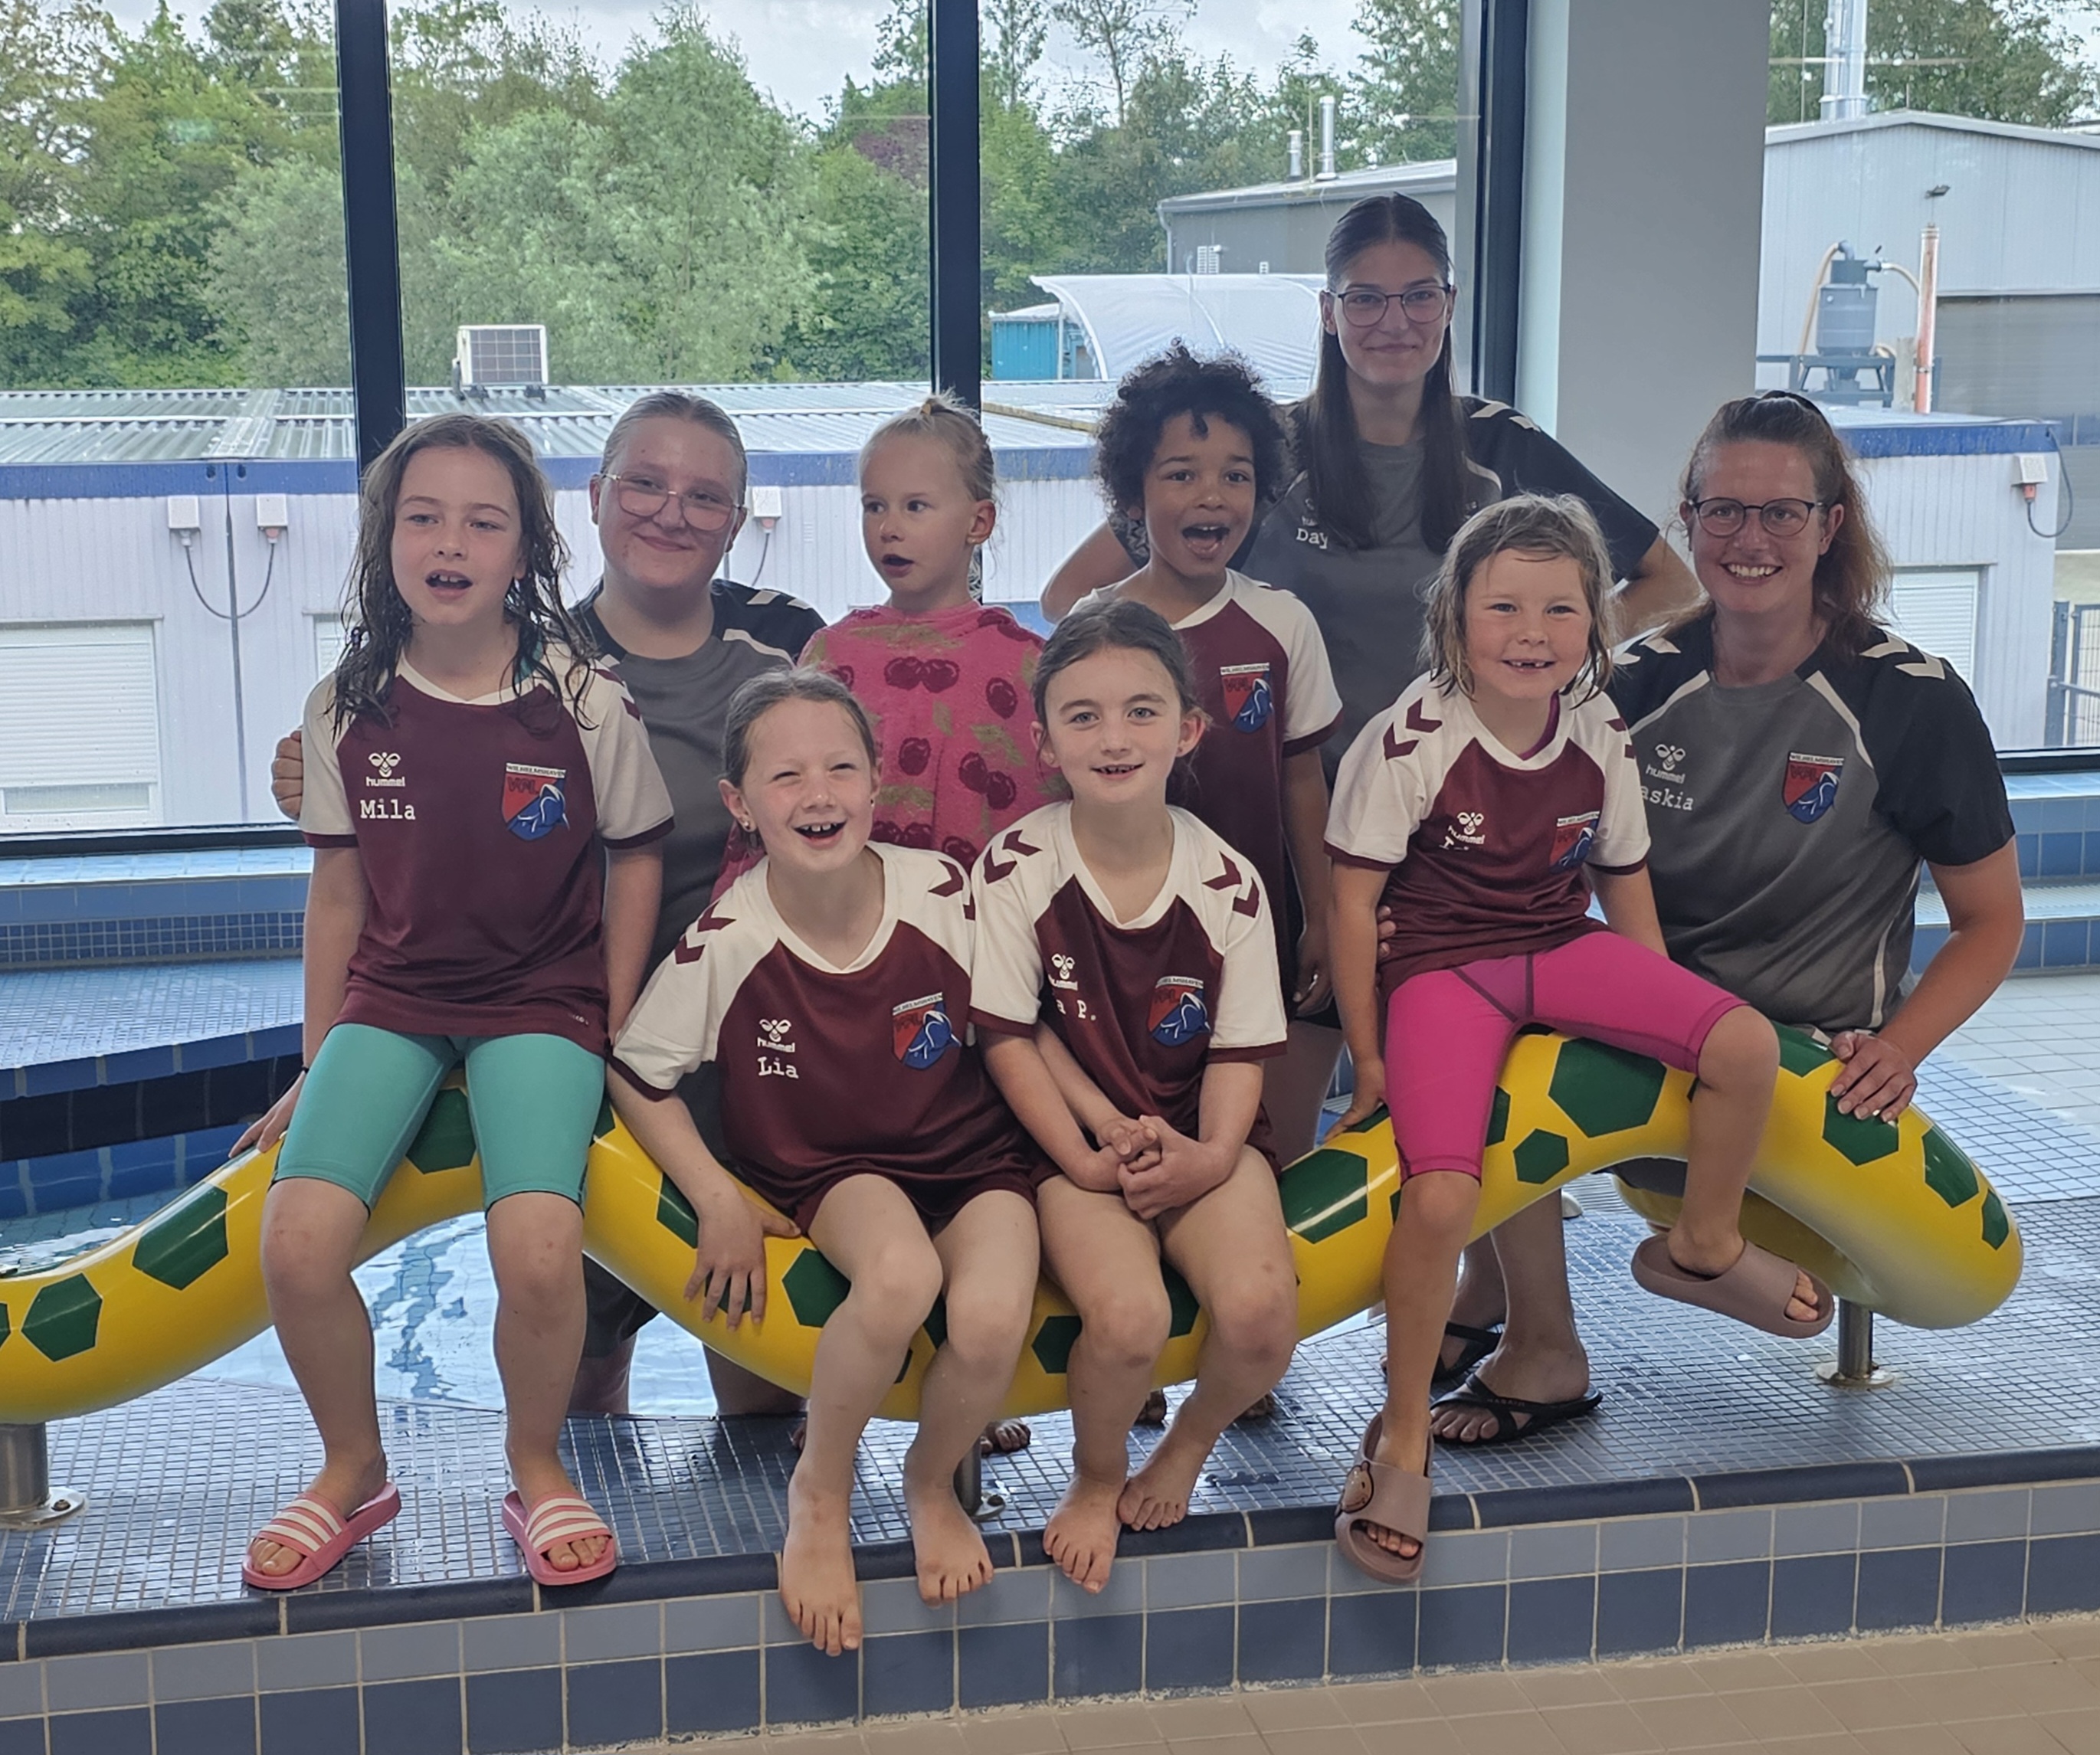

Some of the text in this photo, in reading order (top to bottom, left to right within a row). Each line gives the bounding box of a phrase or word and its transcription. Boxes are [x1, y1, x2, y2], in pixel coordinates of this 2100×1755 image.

[1296, 528, 1328, 549] Day
[366, 776, 405, 787] hummel
[1645, 764, 1686, 784] hummel
[1640, 786, 1693, 810] askia
[360, 798, 415, 820] Mila
[1448, 825, 1486, 844] hummel
[1076, 1000, 1096, 1020] P.
[757, 1037, 795, 1053] hummel
[757, 1056, 799, 1079] Lia
